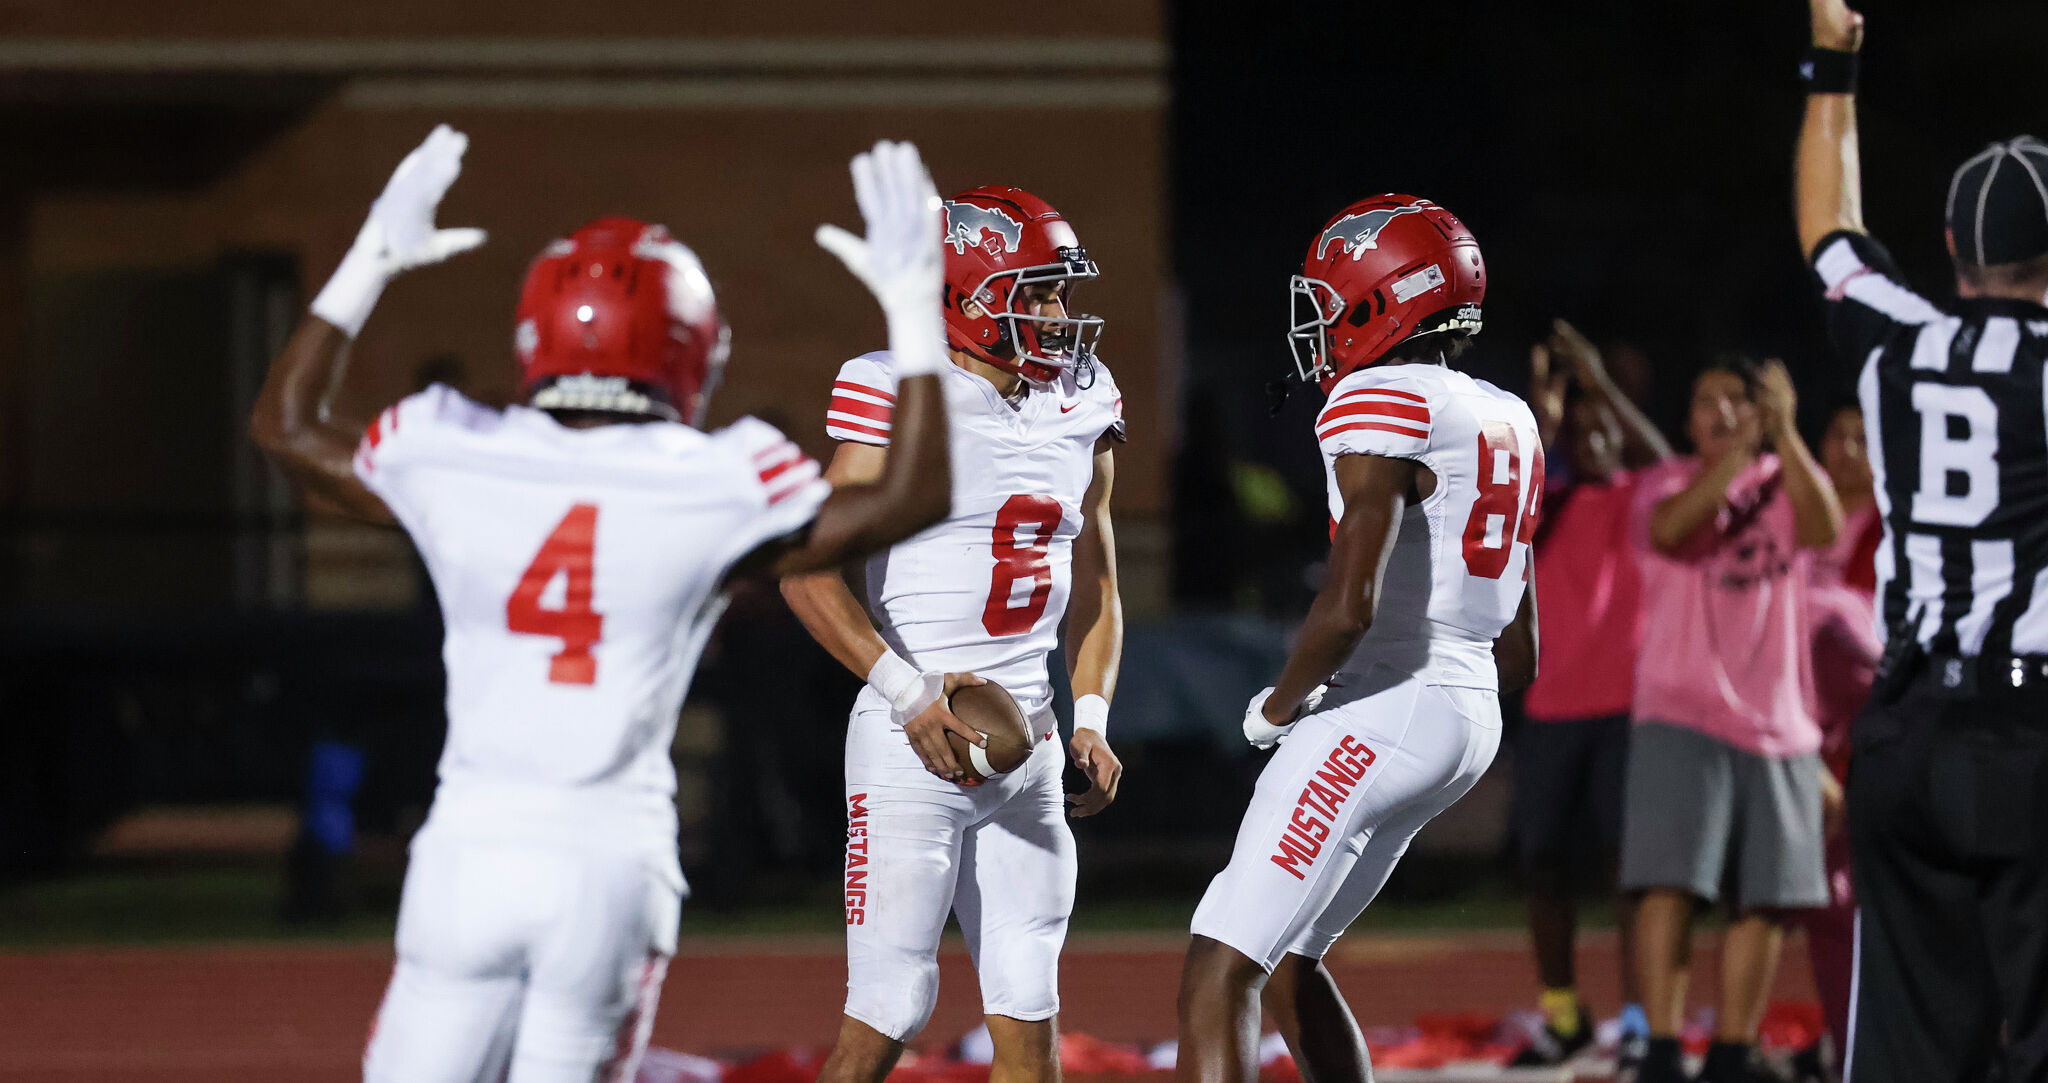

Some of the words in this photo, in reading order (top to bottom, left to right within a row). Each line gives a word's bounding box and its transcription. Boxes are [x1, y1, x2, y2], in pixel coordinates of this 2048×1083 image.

[1462, 420, 1546, 581] 84
[1912, 382, 1999, 527] B
[507, 504, 603, 685] 4
[982, 494, 1063, 637] 8
[1270, 735, 1377, 881] MUSTANGS
